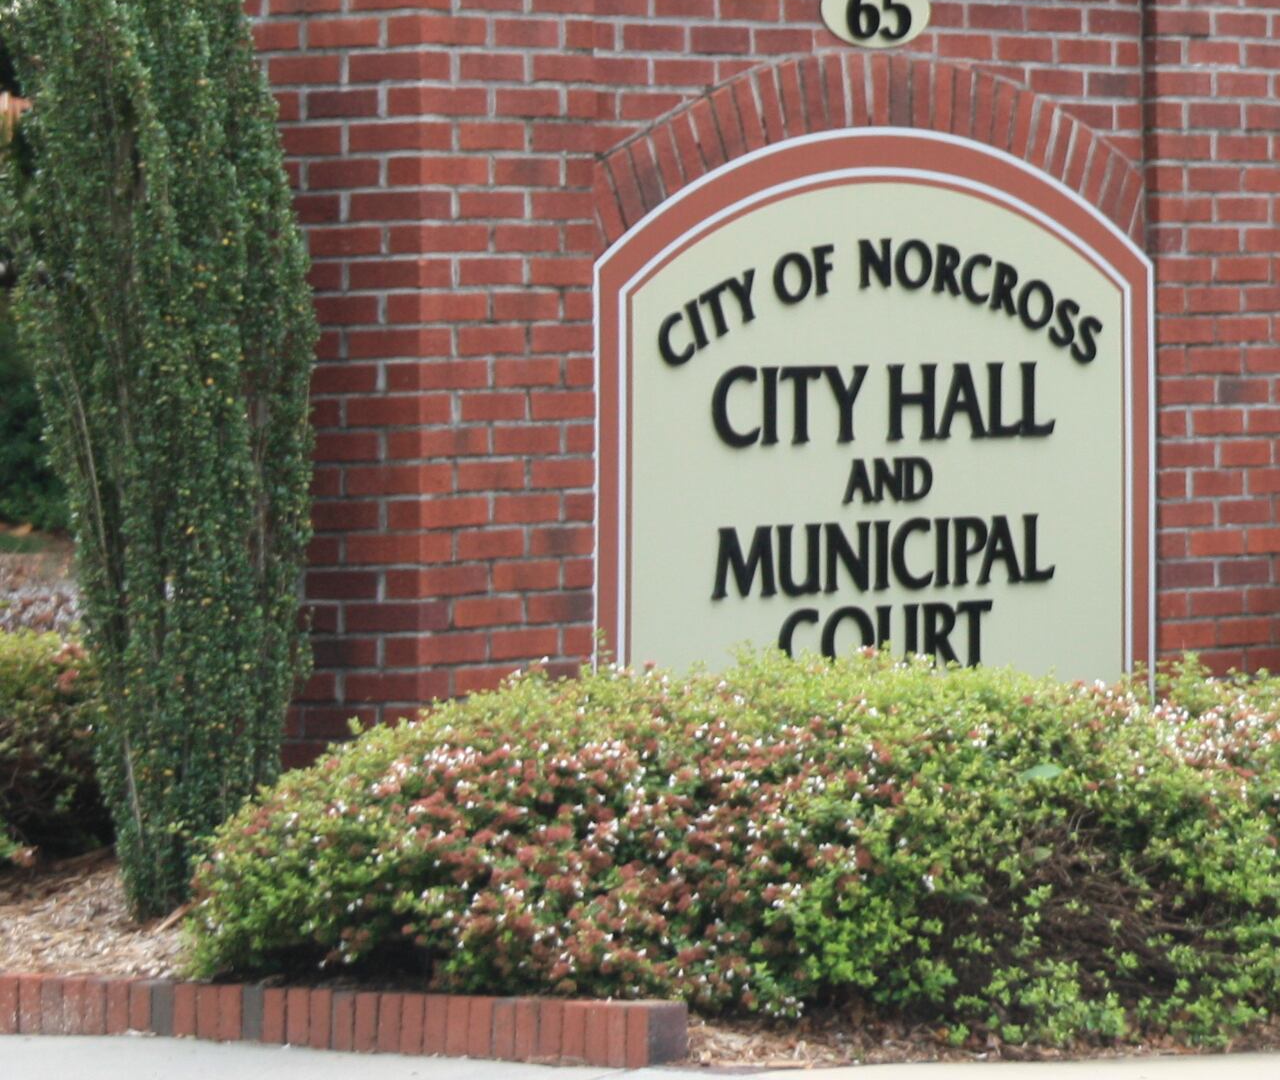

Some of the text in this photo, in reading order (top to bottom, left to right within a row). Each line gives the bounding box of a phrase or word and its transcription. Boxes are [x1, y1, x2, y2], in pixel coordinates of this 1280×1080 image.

[657, 238, 1104, 368] CITY OF NORCROSS
[711, 361, 1056, 449] CITY HALL
[842, 456, 934, 506] AND
[711, 513, 1056, 602] MUNICIPAL
[777, 599, 993, 668] COURT
